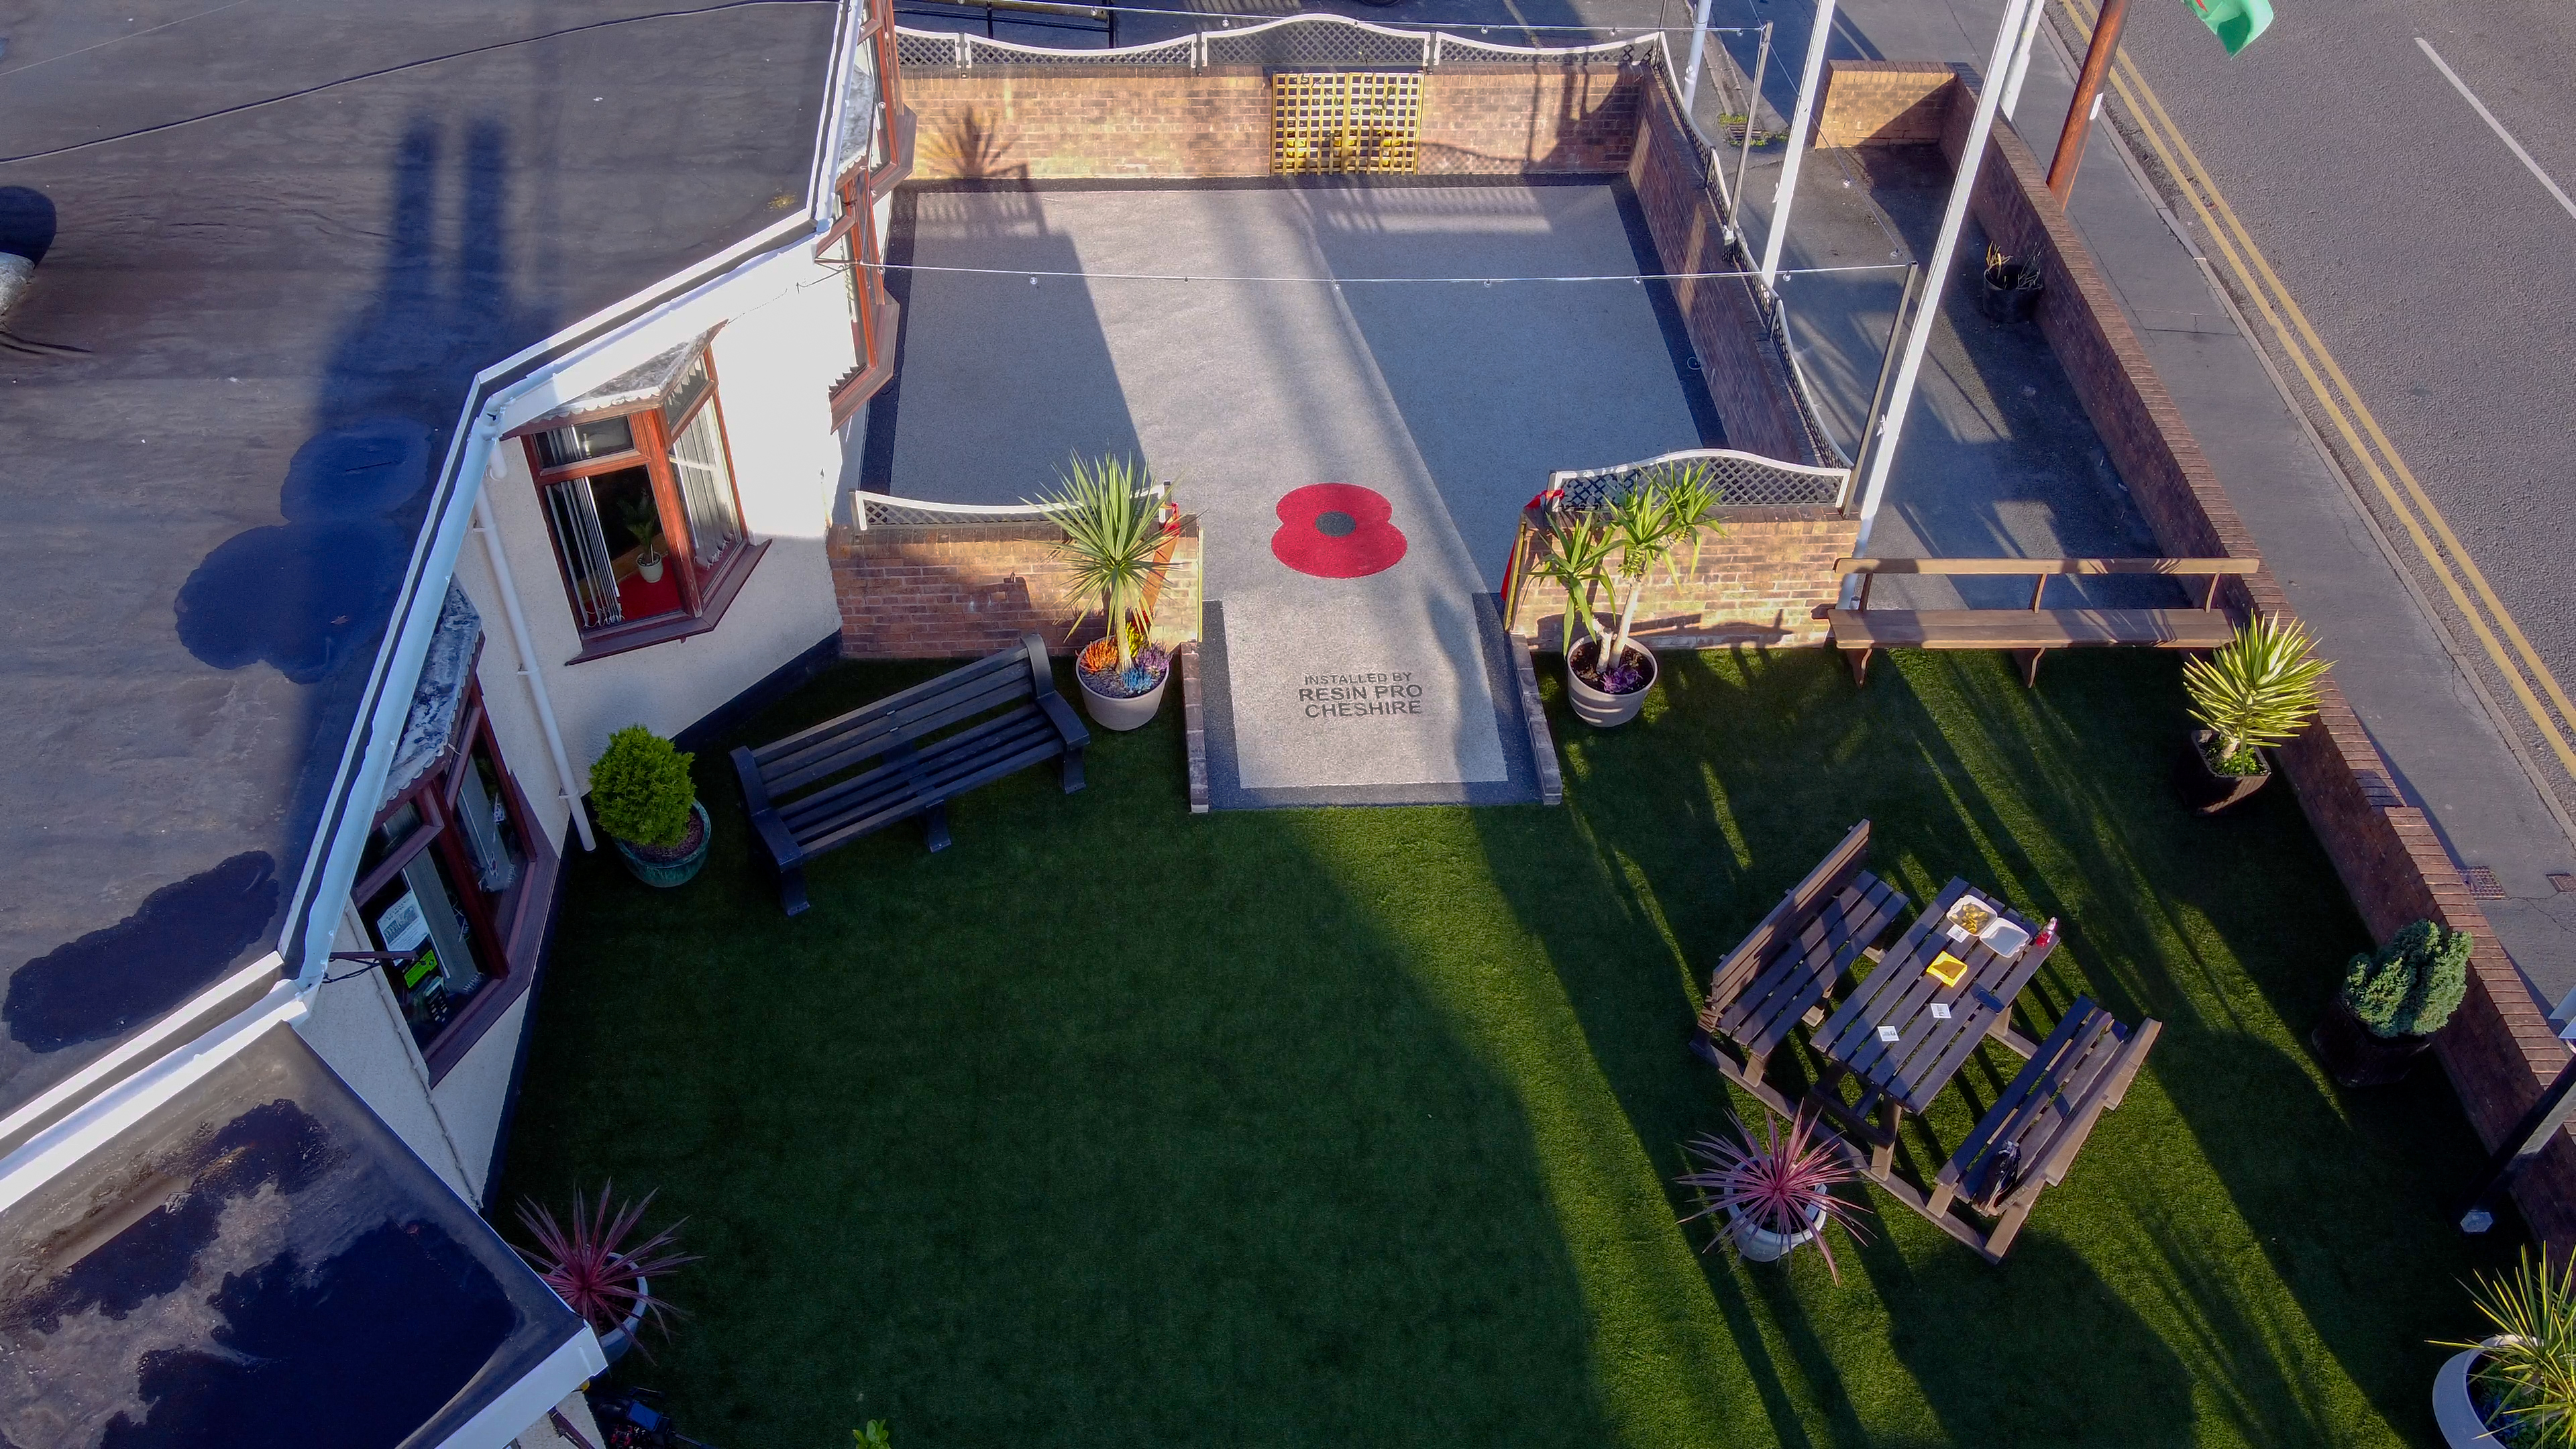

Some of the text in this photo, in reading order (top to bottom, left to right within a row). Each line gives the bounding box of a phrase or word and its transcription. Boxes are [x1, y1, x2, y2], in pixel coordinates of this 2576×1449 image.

[1305, 672, 1412, 685] INSTALLED BY
[1375, 684, 1423, 699] PRO
[1305, 700, 1422, 718] CHESHIRE
